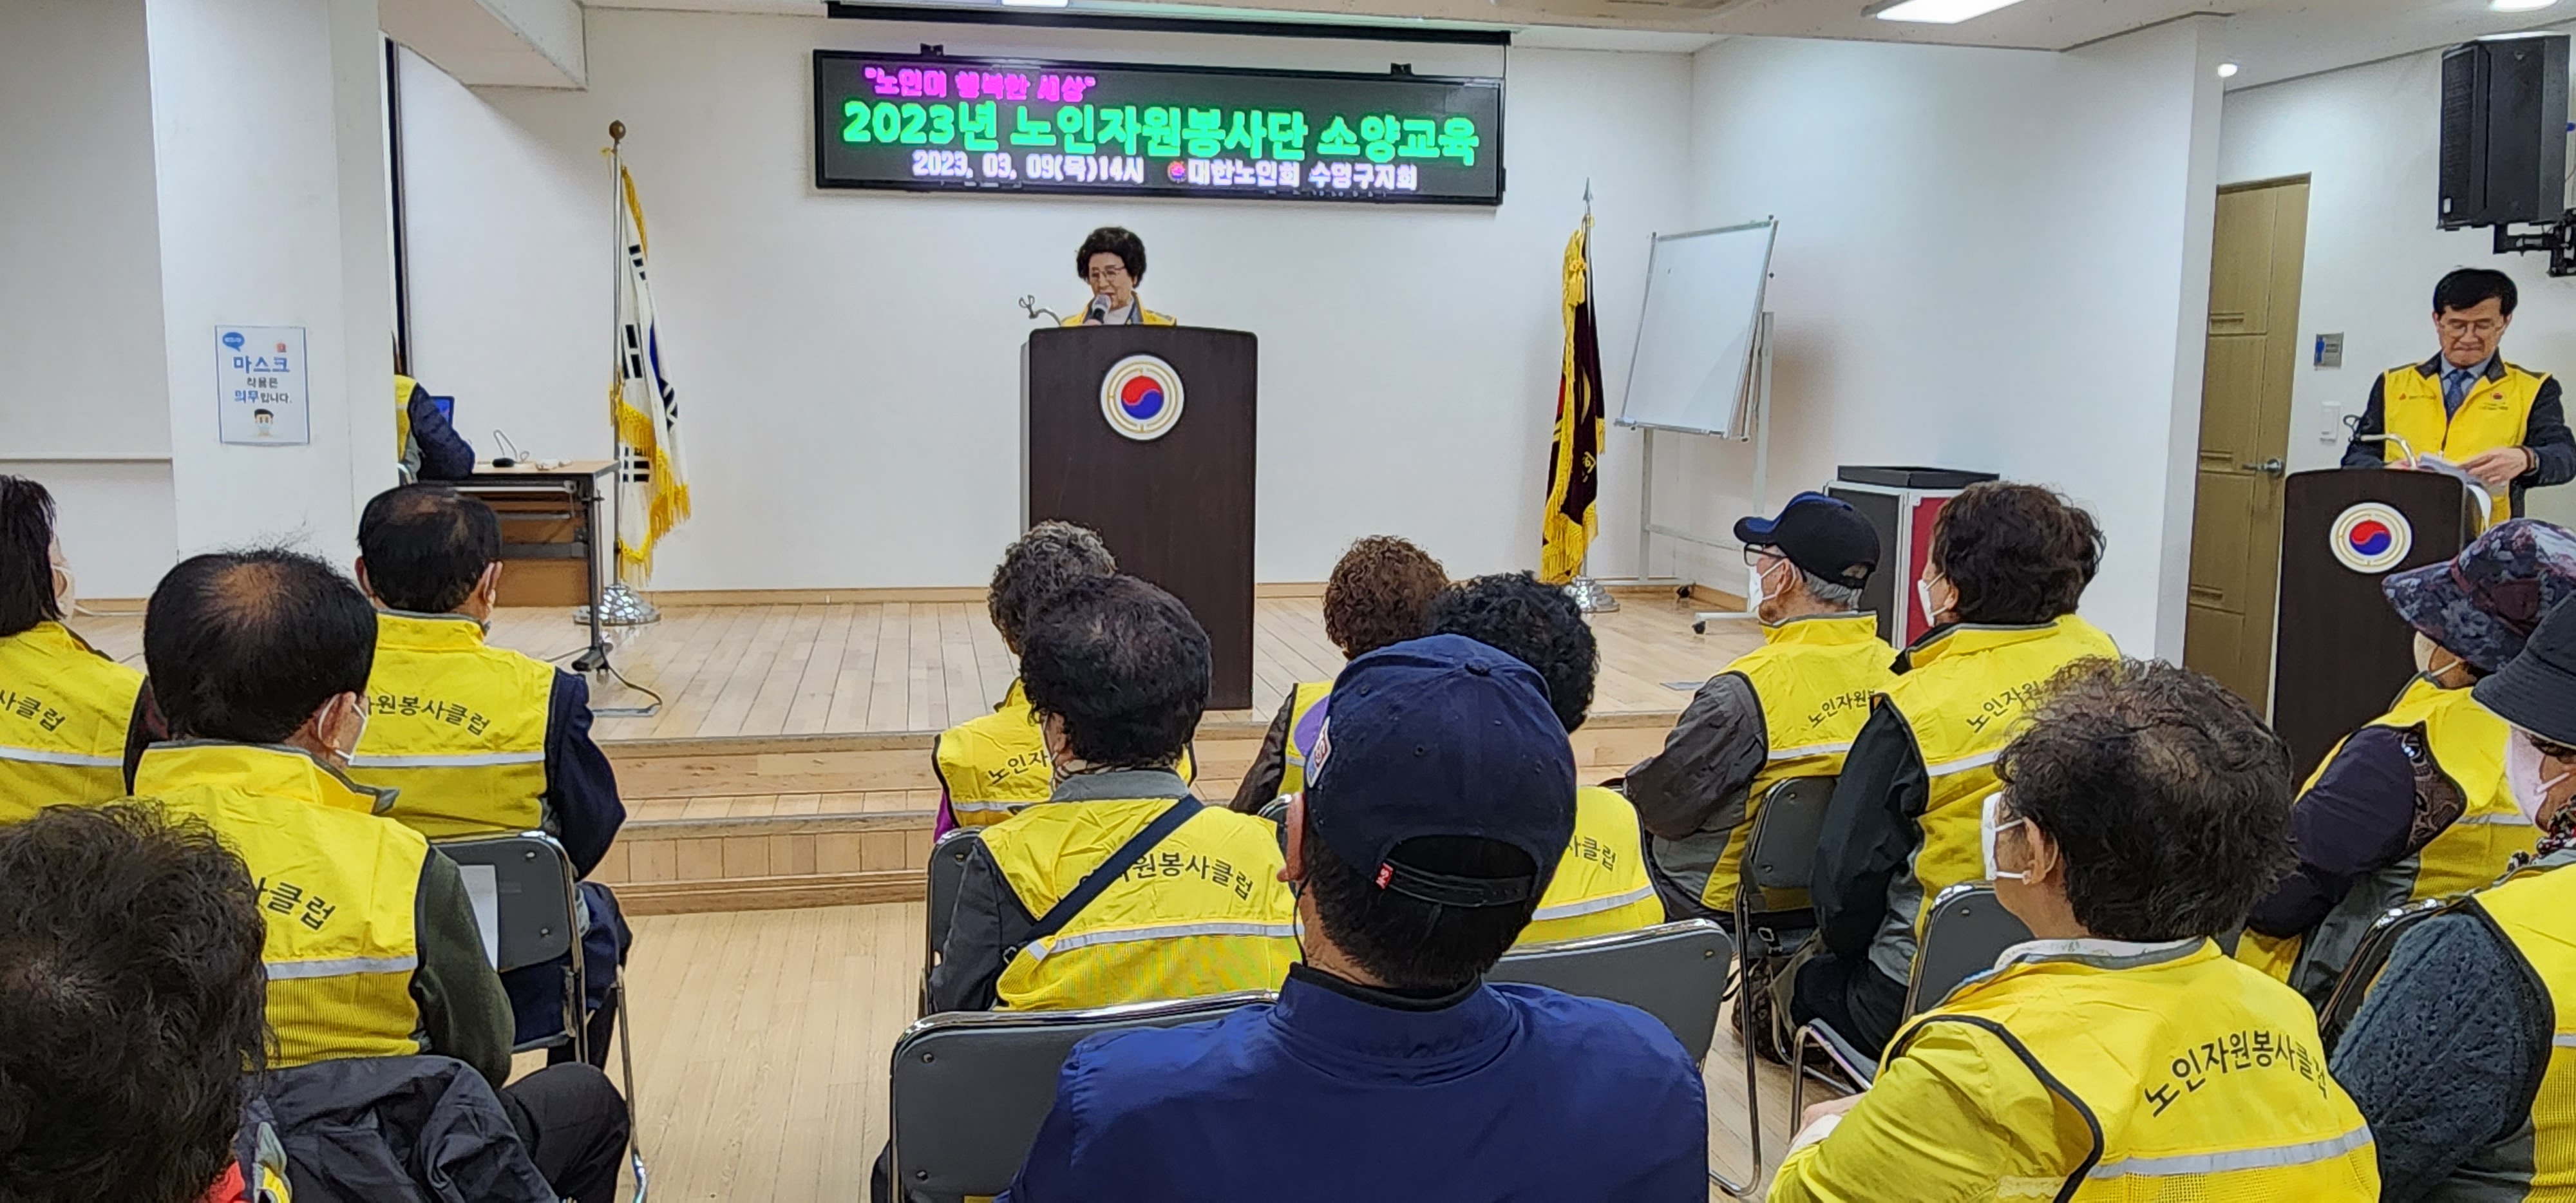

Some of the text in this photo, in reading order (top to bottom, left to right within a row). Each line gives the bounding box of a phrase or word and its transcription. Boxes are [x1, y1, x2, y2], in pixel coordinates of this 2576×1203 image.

[954, 70, 1031, 100] 행복한
[842, 100, 1480, 166] 2023년 노인자원봉사단 소양교육
[1188, 158, 1300, 188] 대한노인회
[1307, 160, 1417, 191] 수영구지회
[232, 355, 290, 374] 마스크
